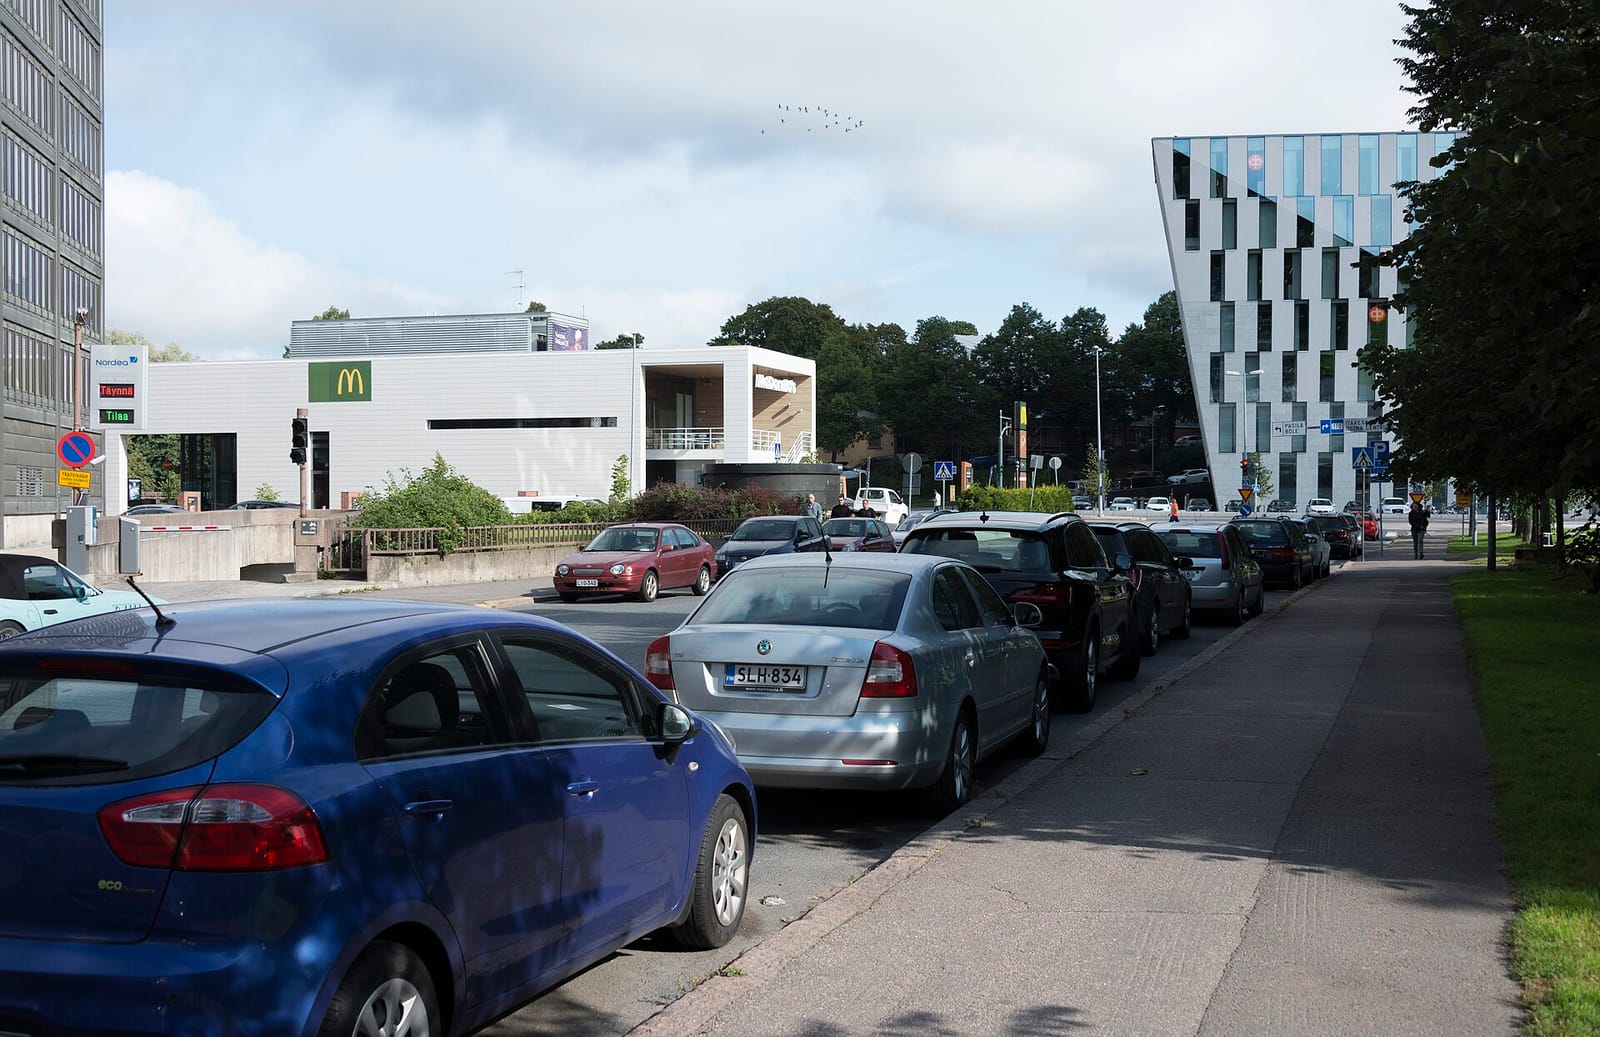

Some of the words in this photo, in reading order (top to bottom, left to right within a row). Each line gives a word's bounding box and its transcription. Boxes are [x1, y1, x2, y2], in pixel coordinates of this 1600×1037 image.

[95, 358, 129, 366] Nordea
[100, 385, 133, 396] Täynnä
[106, 411, 129, 421] Tilaa
[1374, 442, 1387, 459] P
[737, 667, 802, 685] SLH-834
[97, 879, 122, 891] eco
